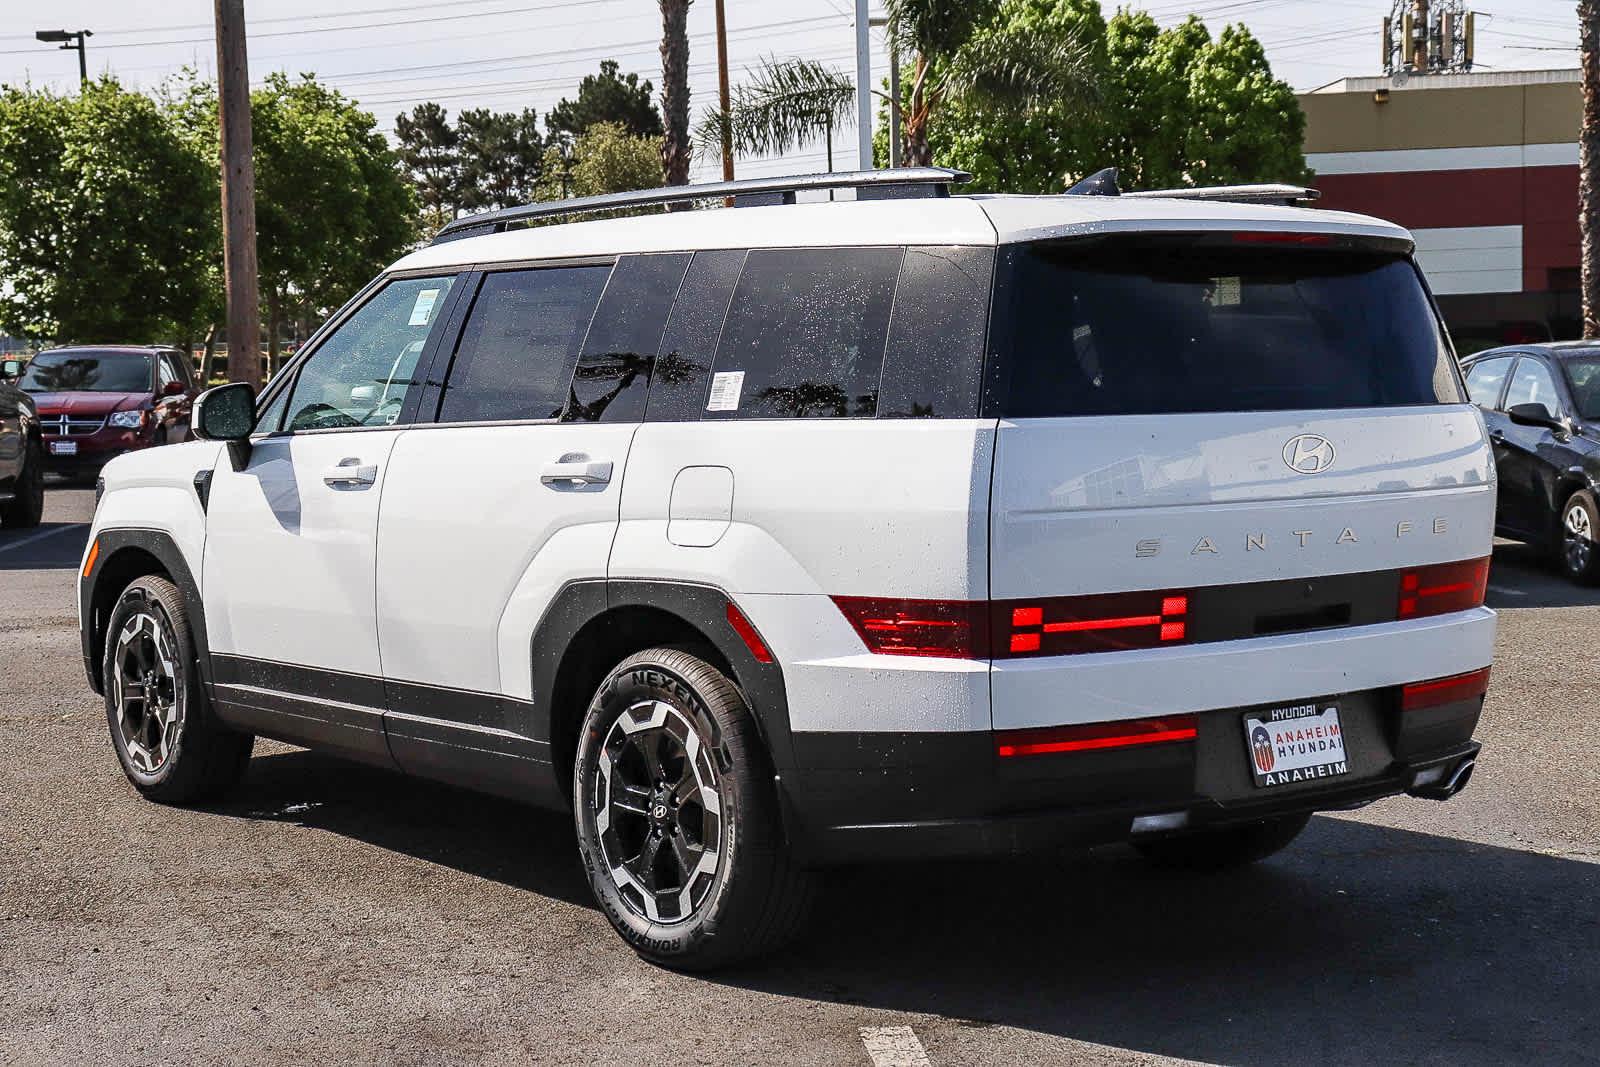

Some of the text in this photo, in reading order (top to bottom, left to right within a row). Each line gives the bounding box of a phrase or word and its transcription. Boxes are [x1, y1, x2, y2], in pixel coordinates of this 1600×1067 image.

[1135, 516, 1449, 558] SANTA FE
[632, 671, 701, 715] NEXEN
[1271, 704, 1316, 721] HYUNDAI
[1275, 724, 1340, 745] ANAHEIM
[1277, 738, 1342, 758] HYUNDAI
[1265, 761, 1347, 786] ANAHEIM
